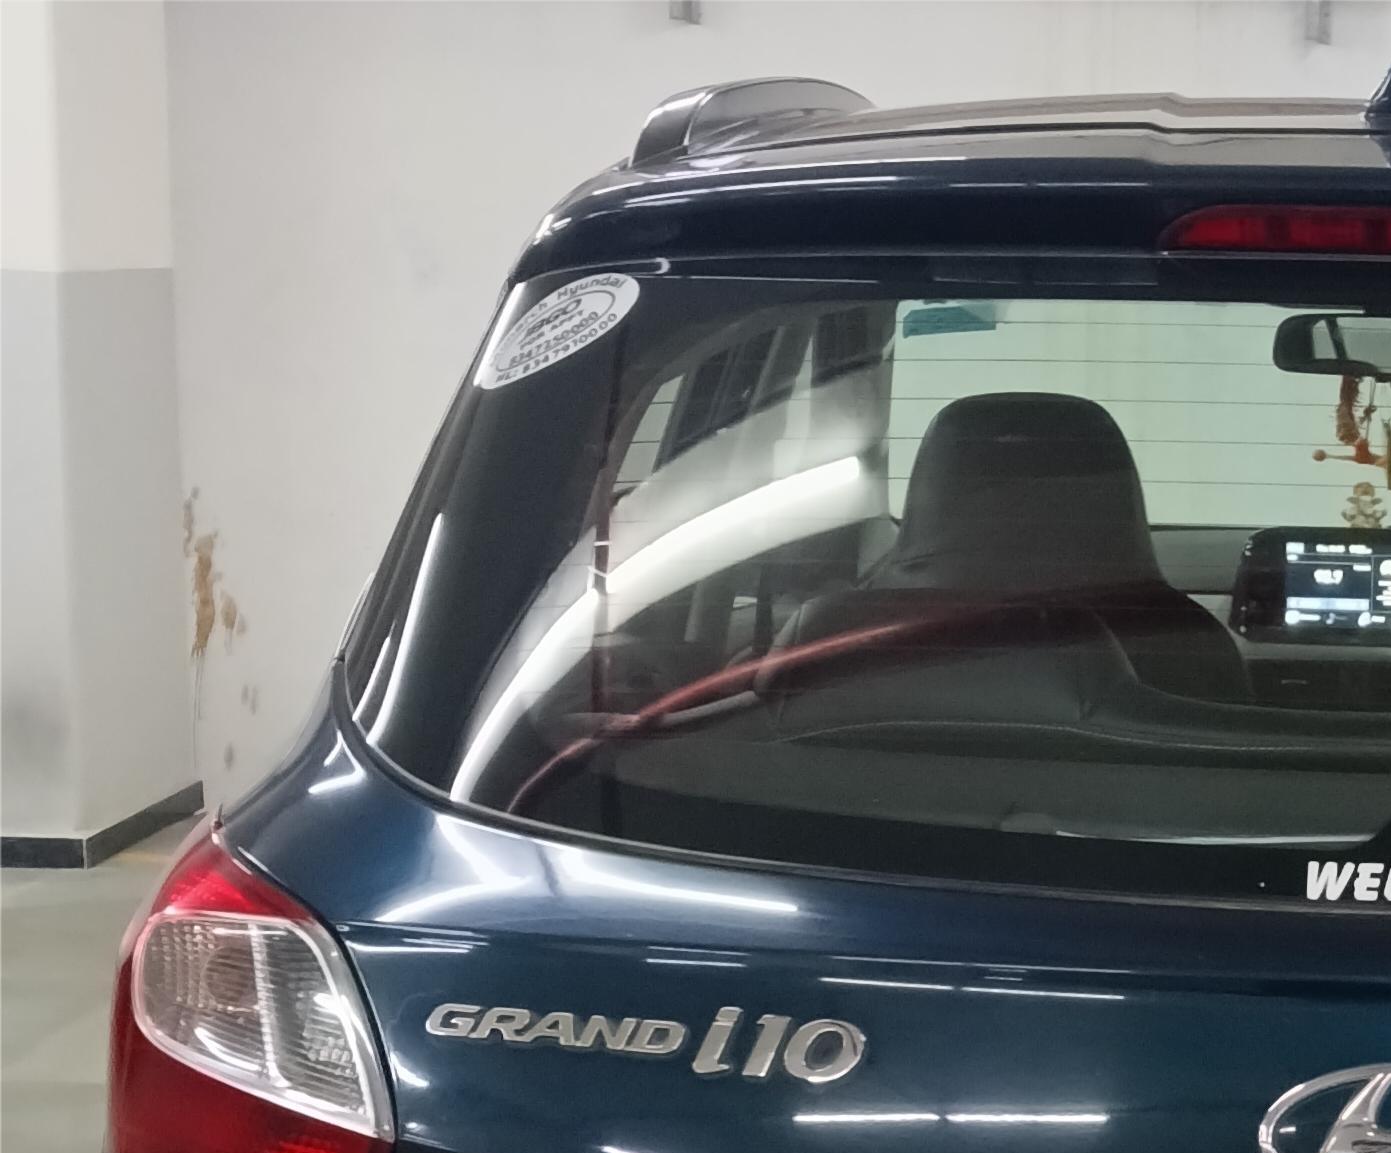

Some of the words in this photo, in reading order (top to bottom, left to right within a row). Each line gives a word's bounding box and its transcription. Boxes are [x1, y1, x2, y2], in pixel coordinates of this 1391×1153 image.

[557, 276, 628, 299] Hyundai
[425, 1003, 686, 1054] GRAND
[692, 1006, 867, 1083] i10
